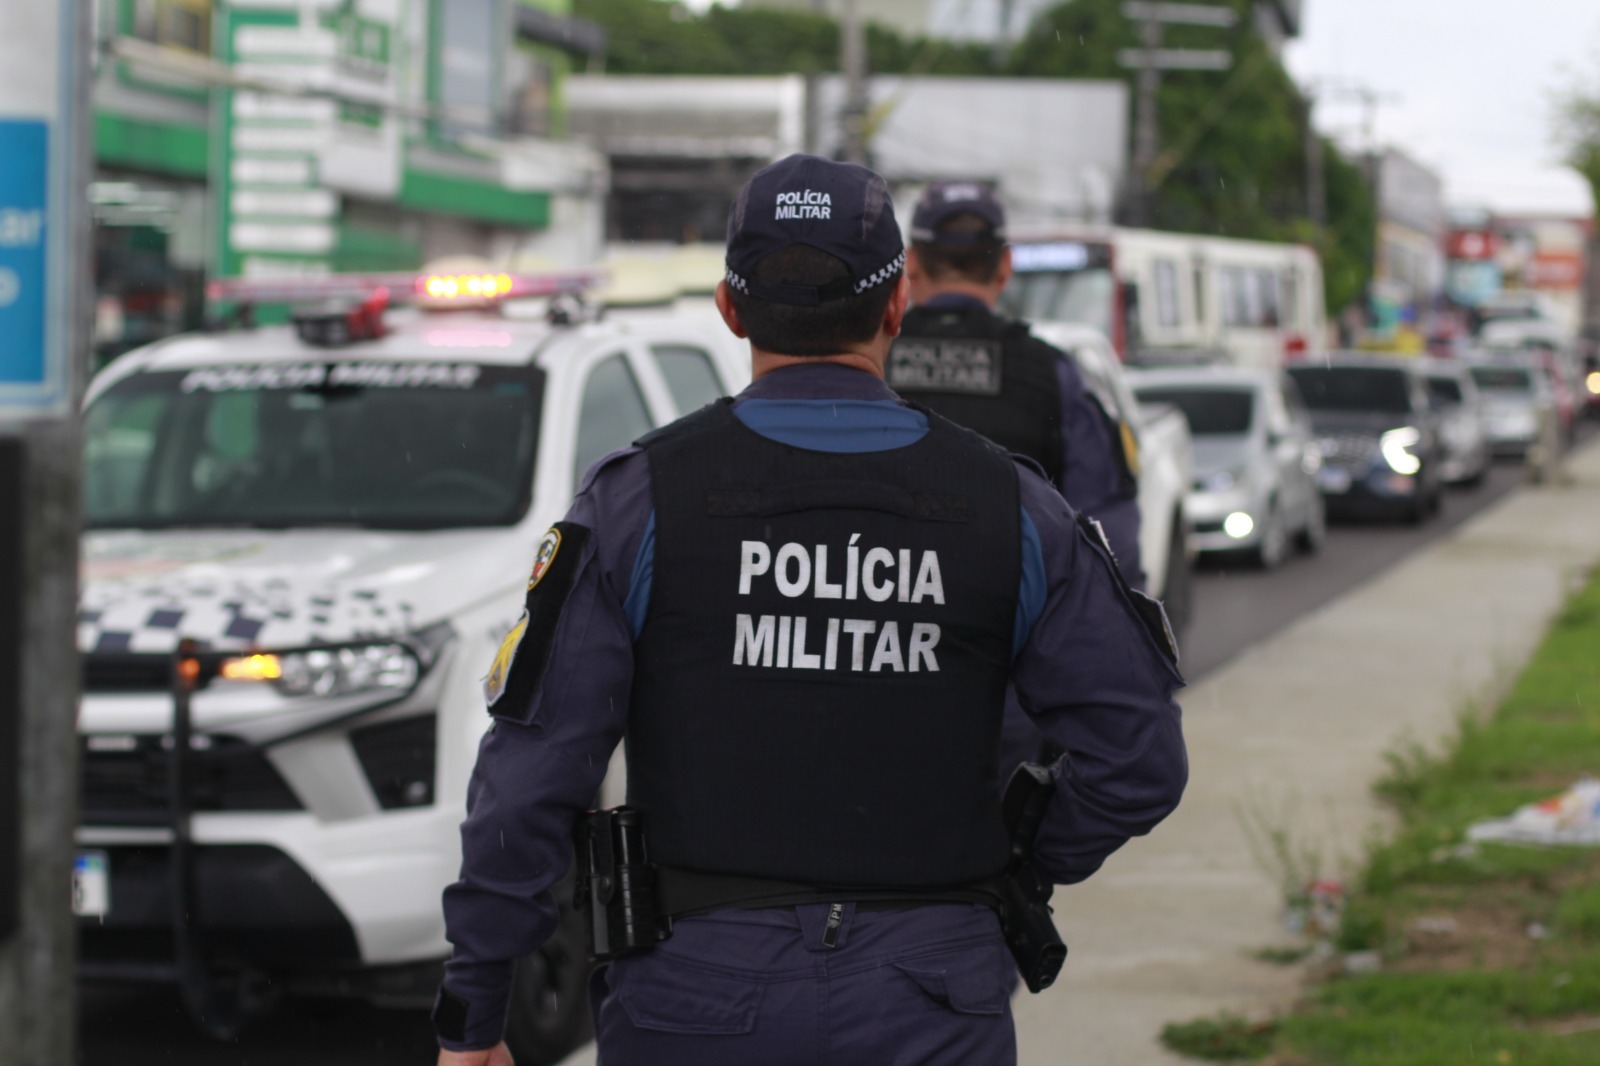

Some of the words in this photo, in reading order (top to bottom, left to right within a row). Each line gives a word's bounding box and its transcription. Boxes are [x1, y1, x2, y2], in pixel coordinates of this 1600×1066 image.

[775, 189, 832, 205] POLÍCIA
[775, 205, 832, 220] MILITAR
[738, 533, 945, 605] POLÍCIA
[732, 613, 941, 673] MILITAR
